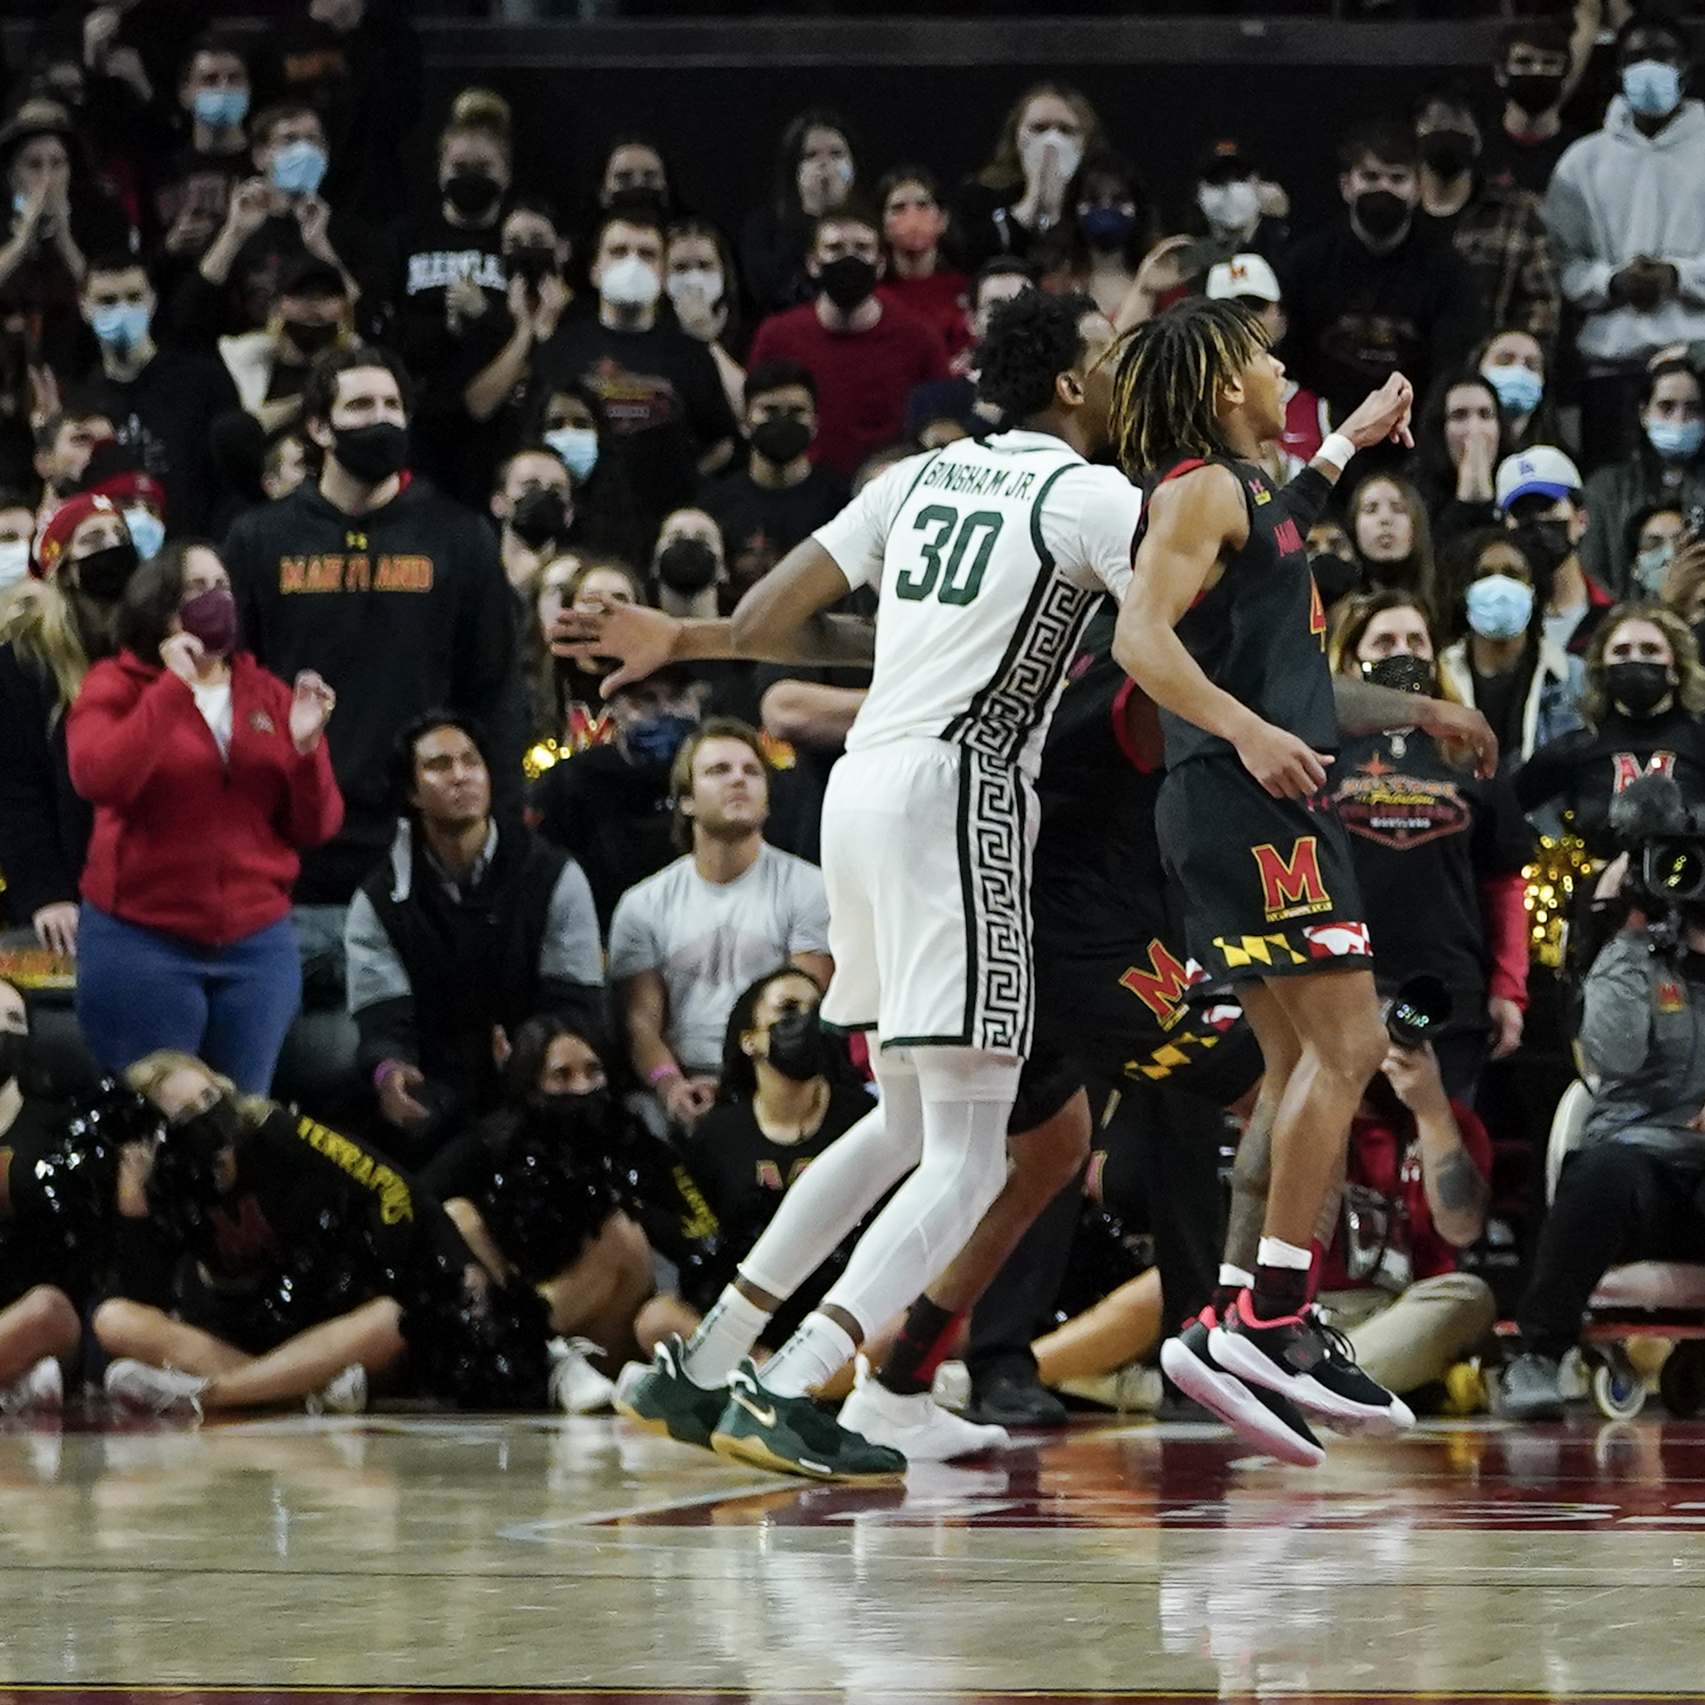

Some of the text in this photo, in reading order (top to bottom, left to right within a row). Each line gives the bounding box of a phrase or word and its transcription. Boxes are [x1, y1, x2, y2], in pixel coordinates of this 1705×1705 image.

[923, 461, 1012, 496] BINGHAM
[895, 503, 1005, 608] 30
[1251, 836, 1331, 912] M
